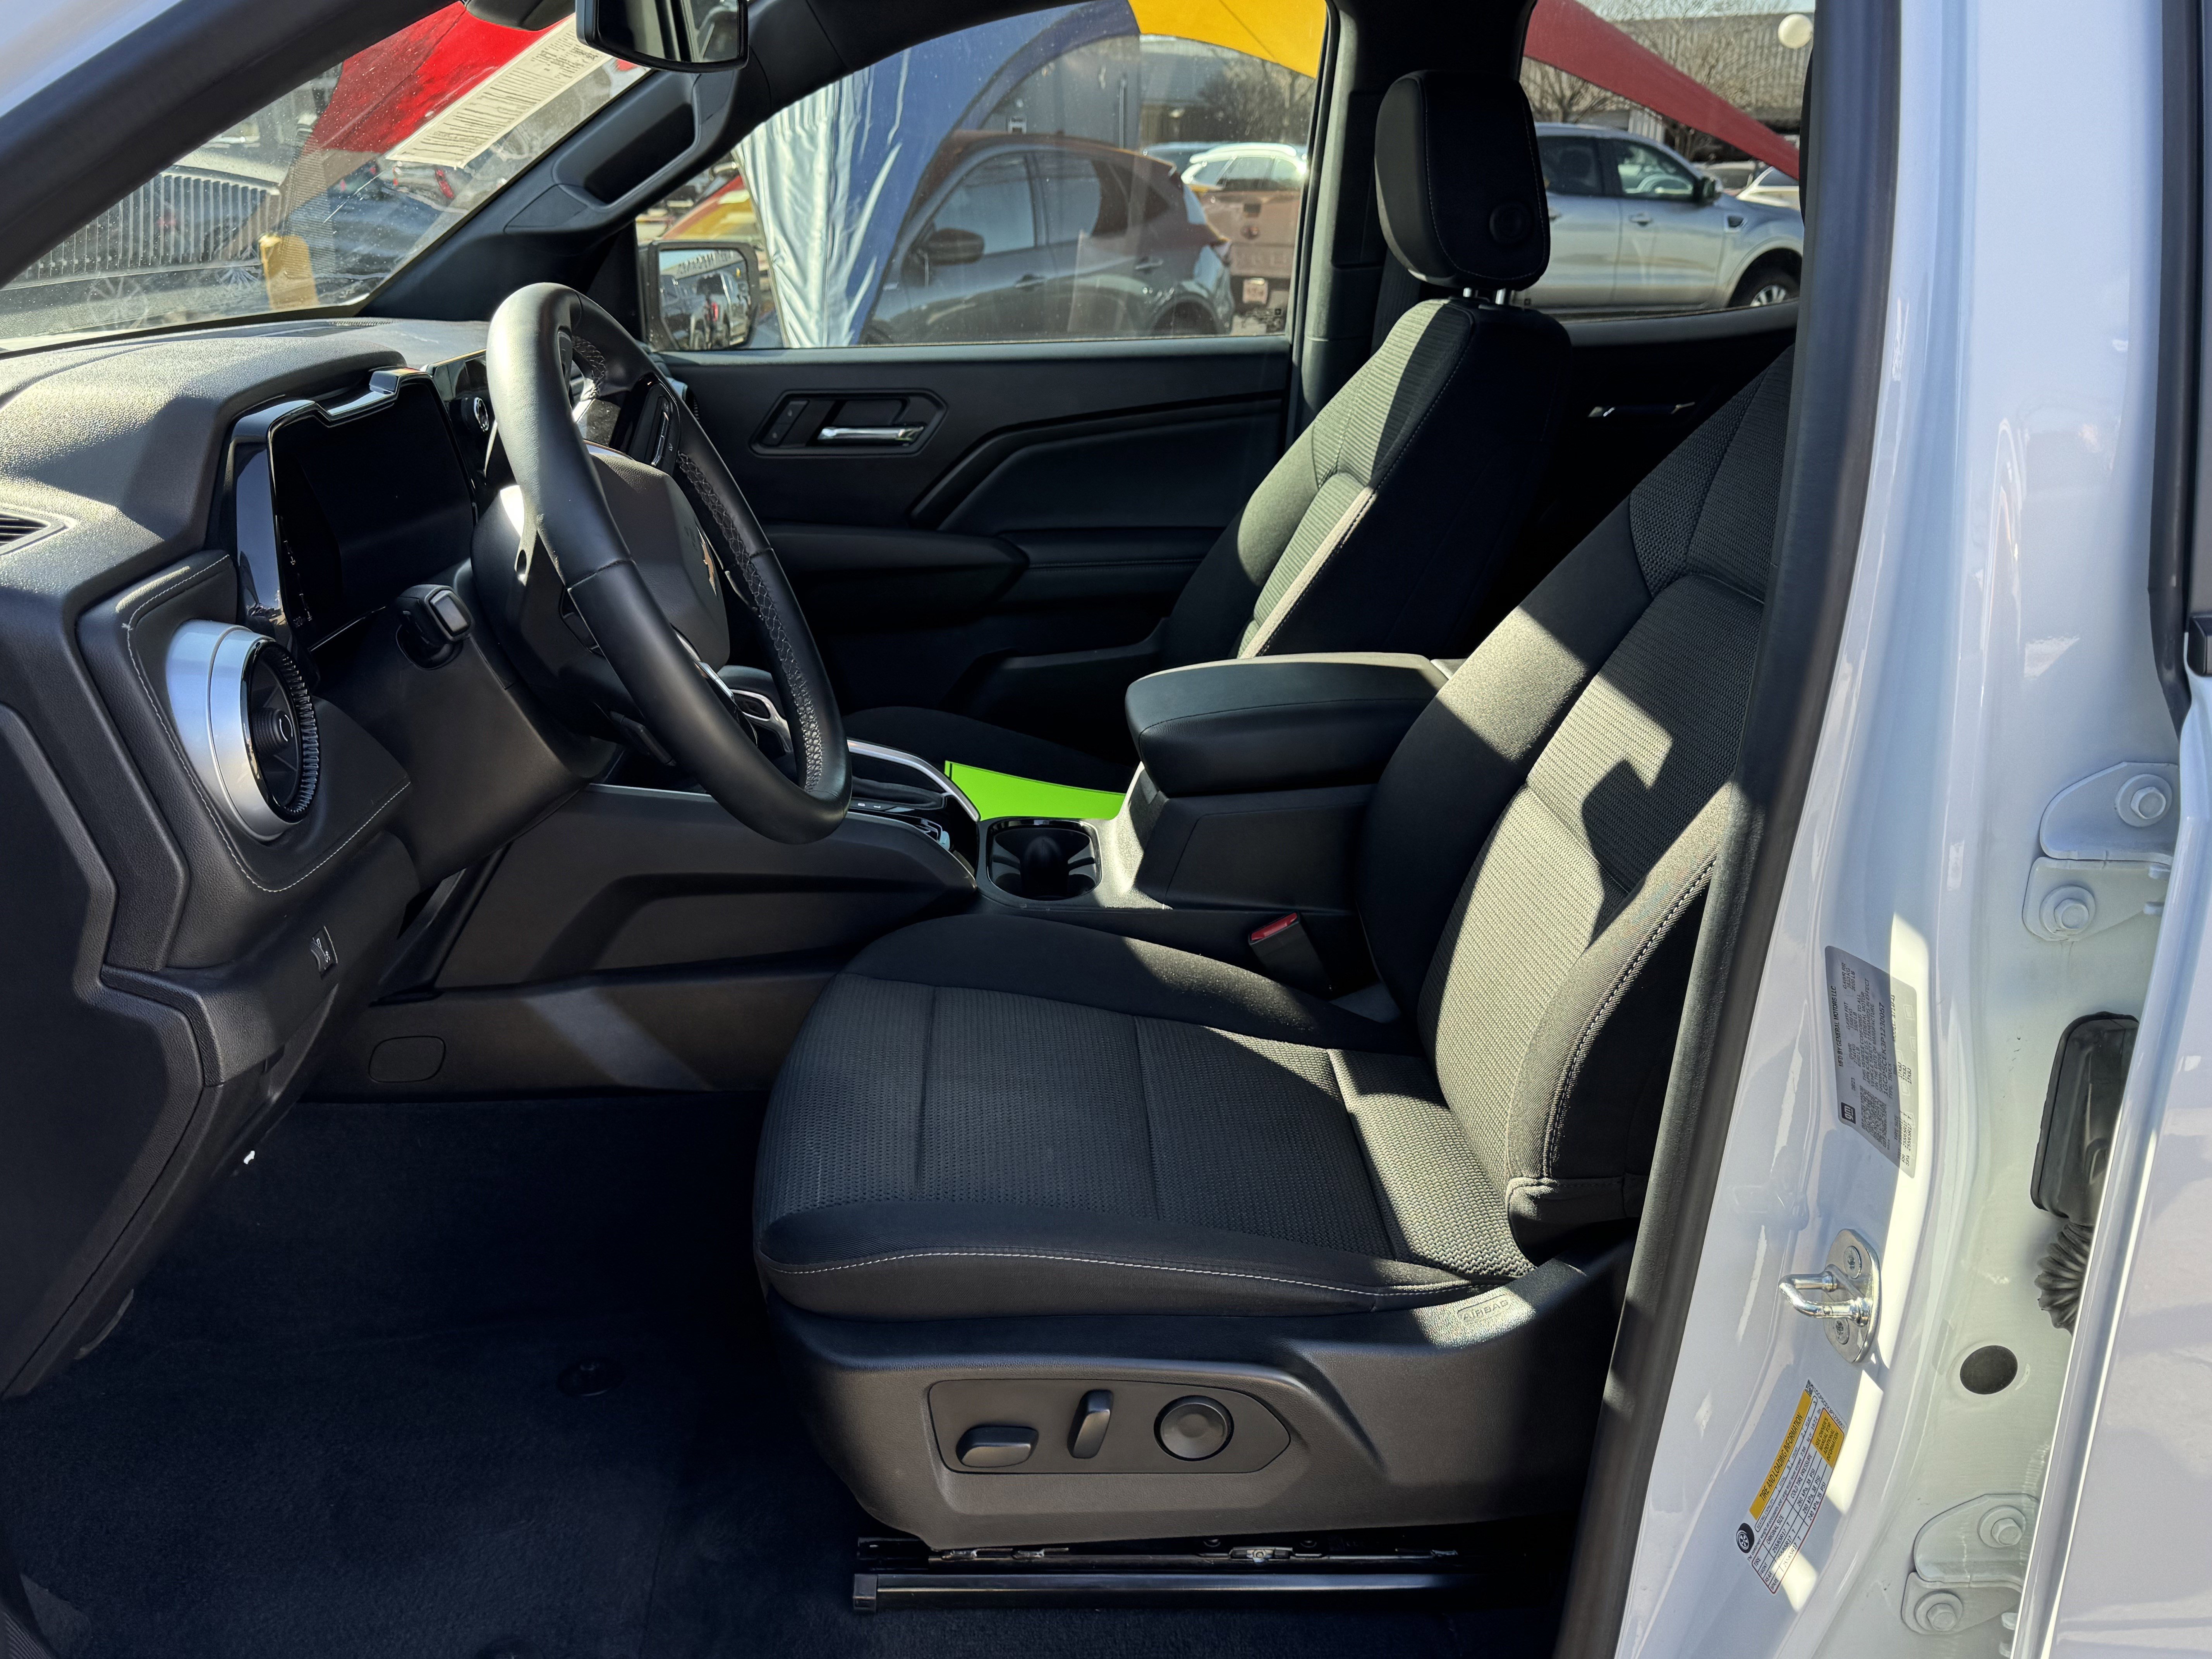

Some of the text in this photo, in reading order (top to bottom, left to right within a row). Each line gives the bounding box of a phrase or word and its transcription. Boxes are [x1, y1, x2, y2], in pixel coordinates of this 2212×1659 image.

[1844, 1106, 1854, 1120] gm
[1463, 1300, 1508, 1320] AIRBAG
[1818, 1416, 1828, 1437] OWNER'S
[1819, 1432, 1828, 1450] MANUAL
[1823, 1429, 1834, 1454] ADDITIONAL
[1826, 1431, 1839, 1461] INFORMATION
[1759, 1413, 1803, 1501] TIRE AND LOADING INFORMATION
[1766, 1524, 1779, 1544] ORIGINAL
[1790, 1485, 1798, 1499] COLD
[1800, 1453, 1812, 1477] PRESSURE
[1772, 1528, 1787, 1553] 255/65R17
